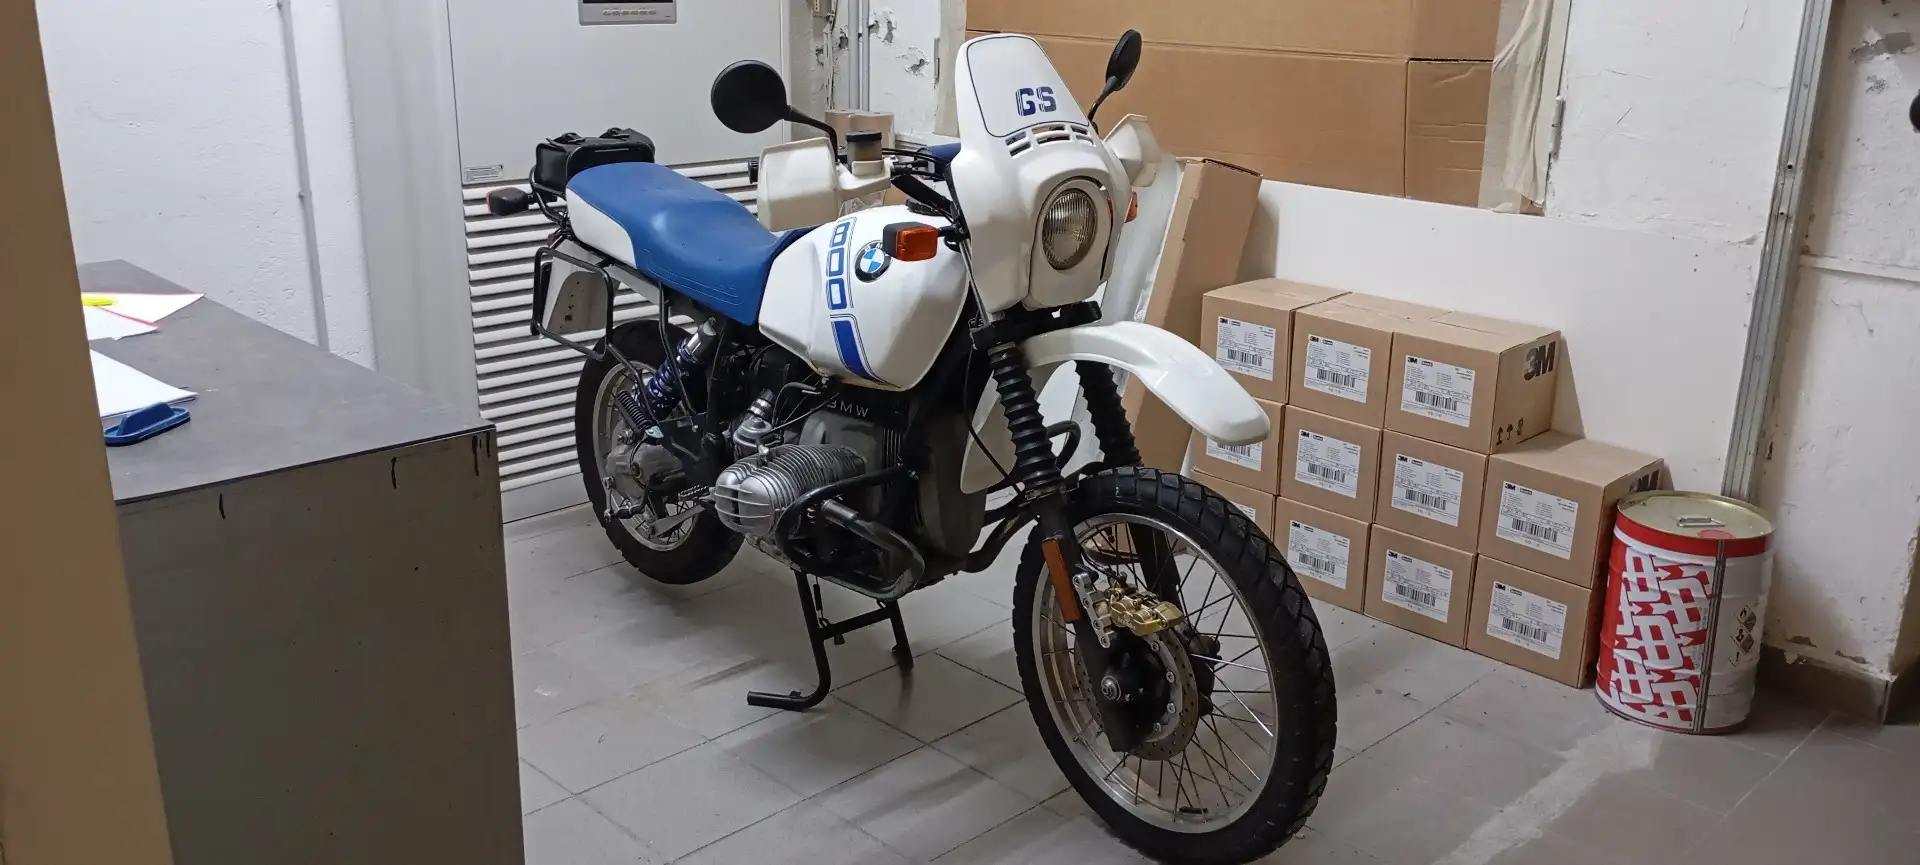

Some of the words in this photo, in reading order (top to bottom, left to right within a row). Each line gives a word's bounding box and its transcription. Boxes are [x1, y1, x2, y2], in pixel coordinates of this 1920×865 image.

[1015, 86, 1057, 117] GS
[825, 221, 848, 311] 800
[1407, 356, 1418, 364] 3M
[1523, 341, 1556, 381] 3M
[1300, 430, 1310, 438] 3M
[1397, 455, 1408, 463] 3M
[1504, 482, 1516, 491] 3M
